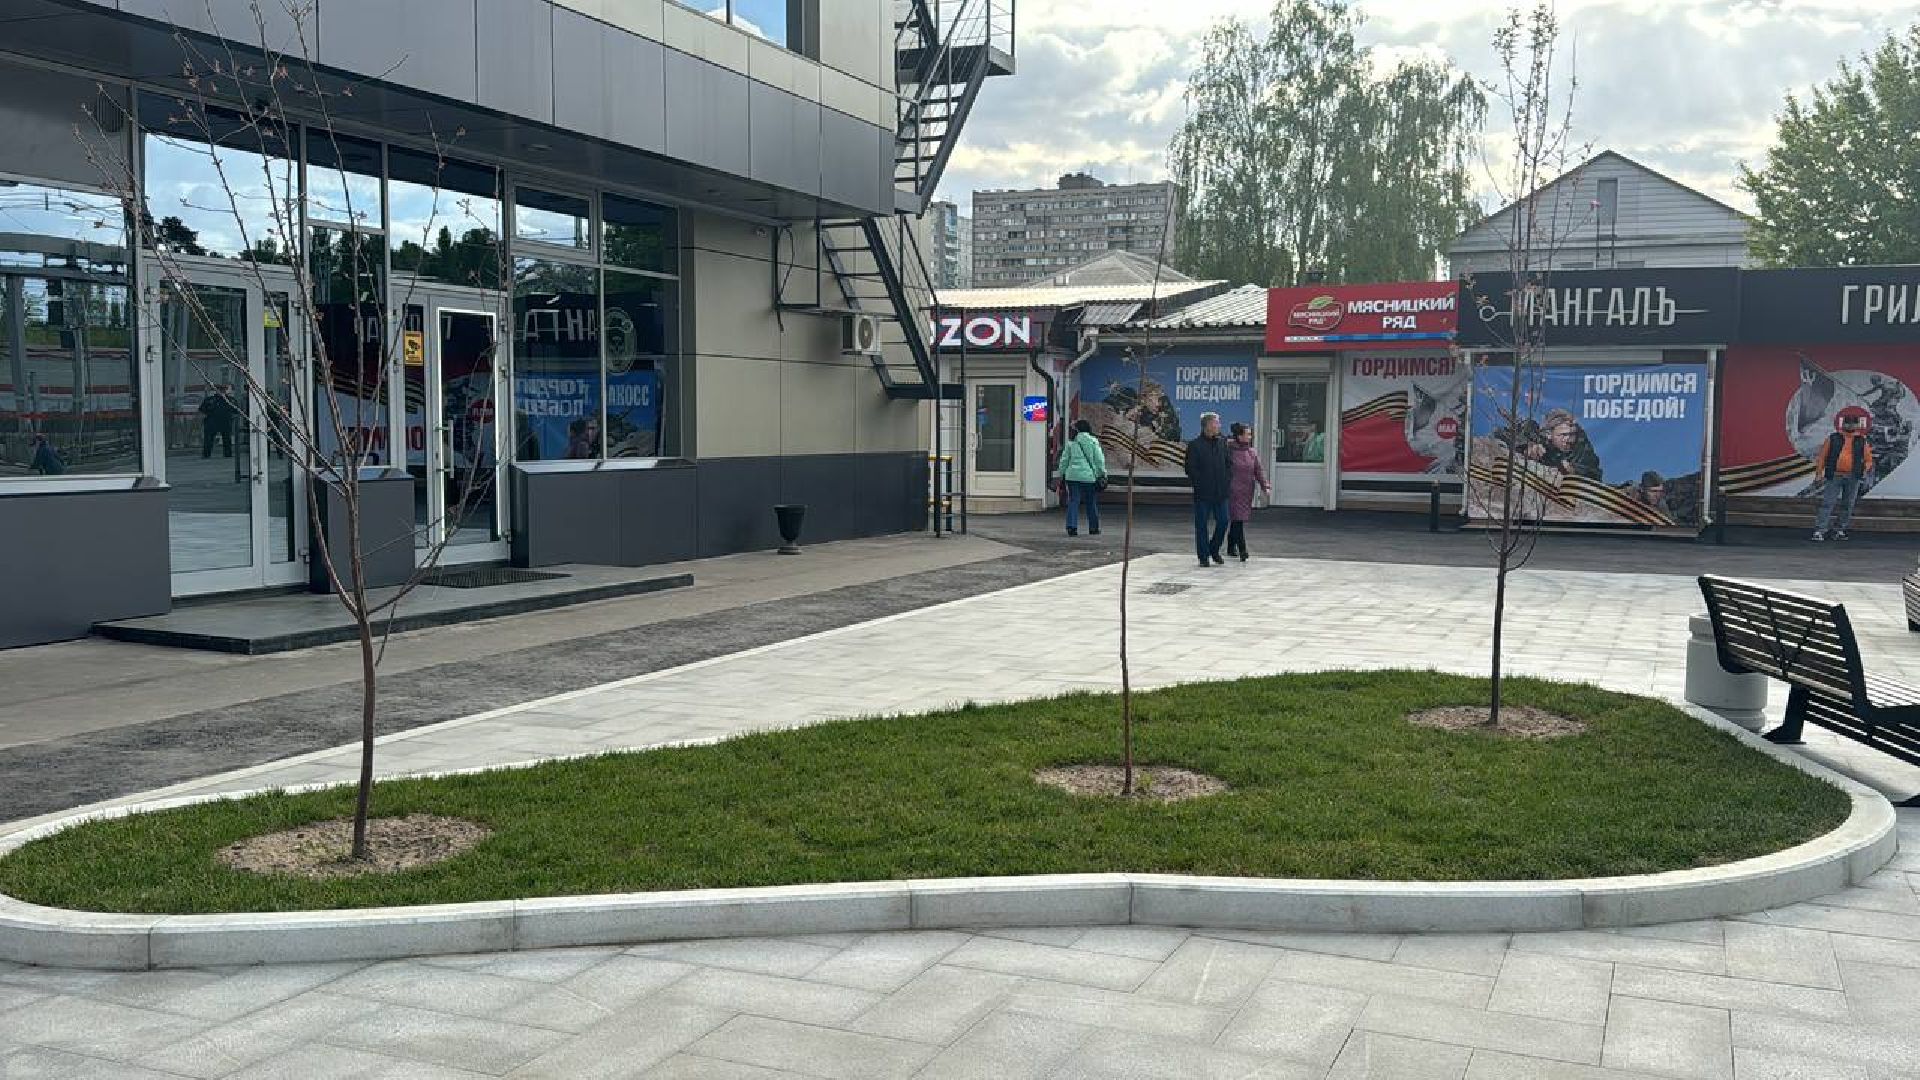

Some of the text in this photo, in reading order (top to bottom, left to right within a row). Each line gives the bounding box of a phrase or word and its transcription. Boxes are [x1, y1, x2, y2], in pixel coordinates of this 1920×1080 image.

[1347, 296, 1456, 313] МЯСНИЦКИЙ
[1382, 315, 1417, 329] РЯД
[1176, 366, 1249, 384] ГОРДИМСЯ
[1352, 356, 1456, 379] ГОРДИМСЯ!
[1176, 383, 1241, 403] ПОБЕДОЙ!
[1583, 372, 1698, 397] ГОРДИМСЯ
[1583, 397, 1685, 421] ПОБЕДОЙ!
